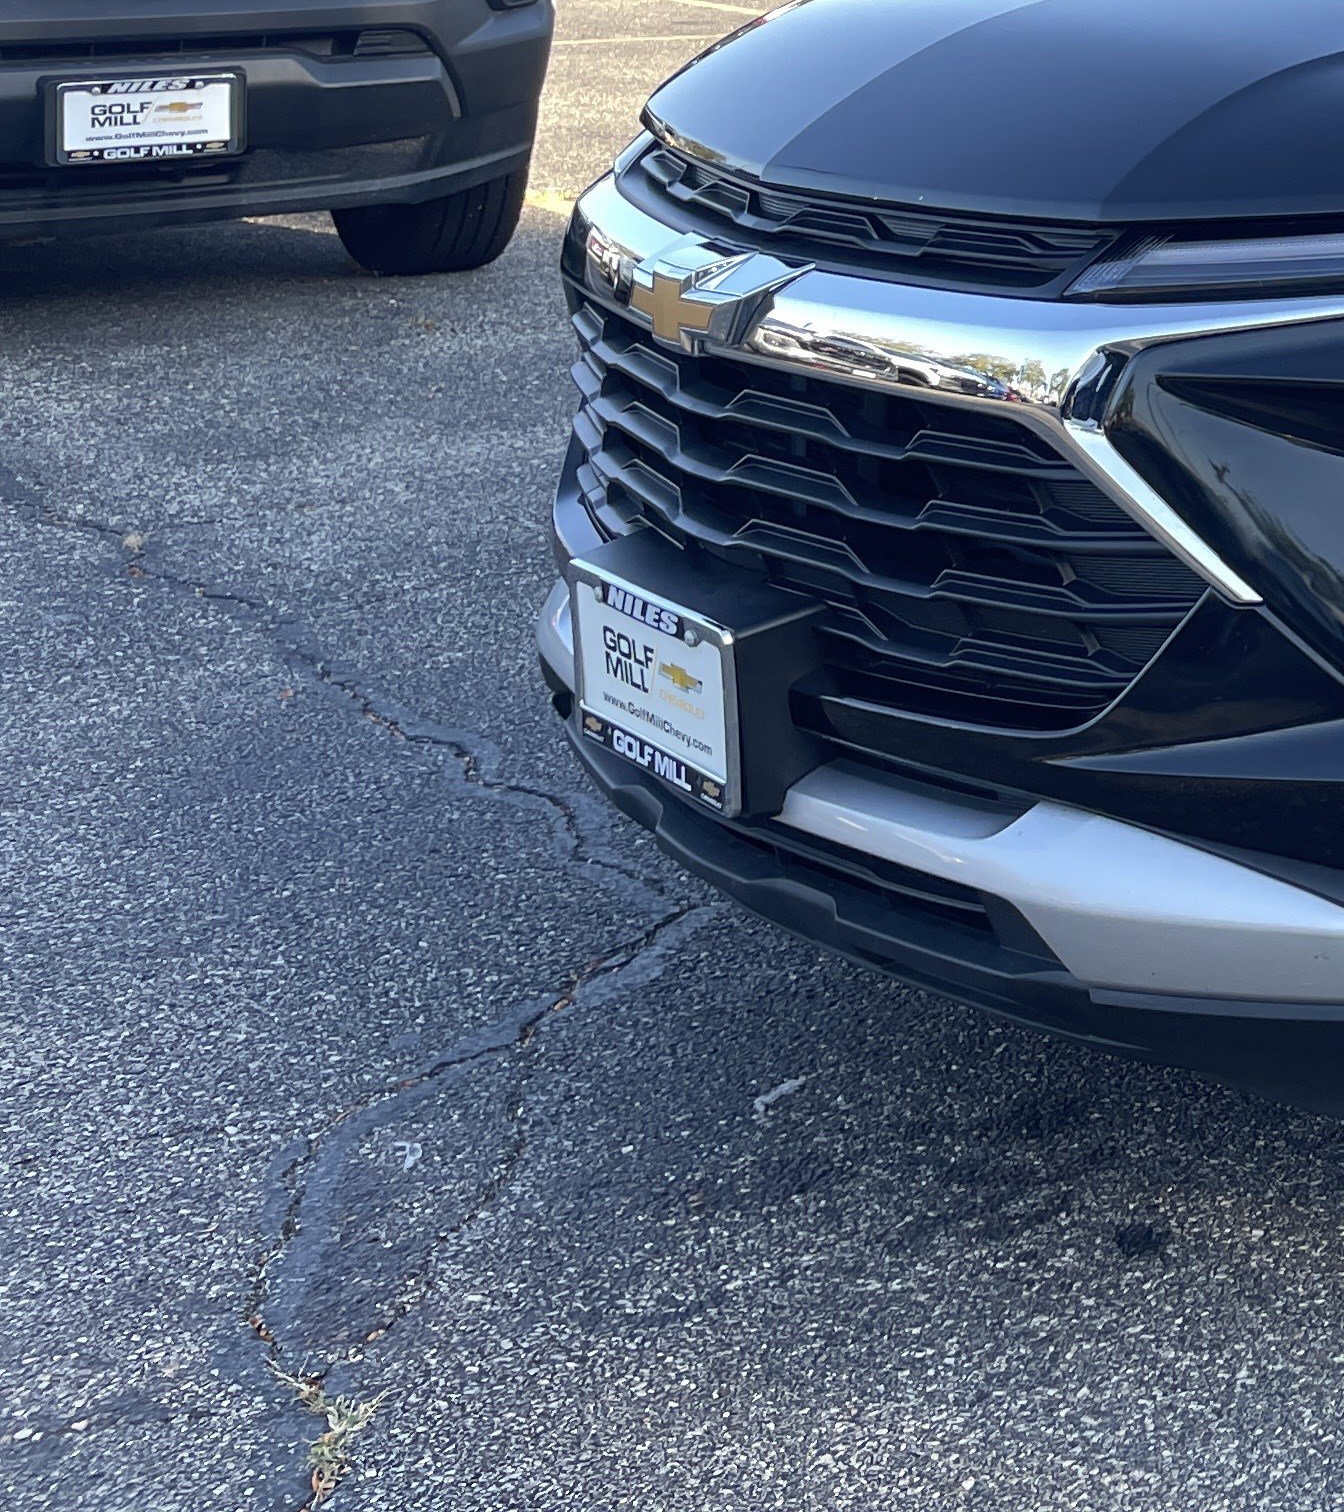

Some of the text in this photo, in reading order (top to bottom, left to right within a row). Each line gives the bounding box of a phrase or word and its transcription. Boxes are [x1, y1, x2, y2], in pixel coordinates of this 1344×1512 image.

[106, 78, 191, 95] NILES
[90, 101, 152, 117] GOLF
[91, 114, 141, 129] MILL
[103, 146, 151, 160] GOLF
[151, 144, 194, 157] MILL
[607, 585, 679, 636] NILES
[602, 624, 655, 670] GOLF
[604, 651, 650, 694] MILL
[603, 691, 713, 757] www.GolfMillChevy.com
[612, 729, 692, 793] GOLF MILL
